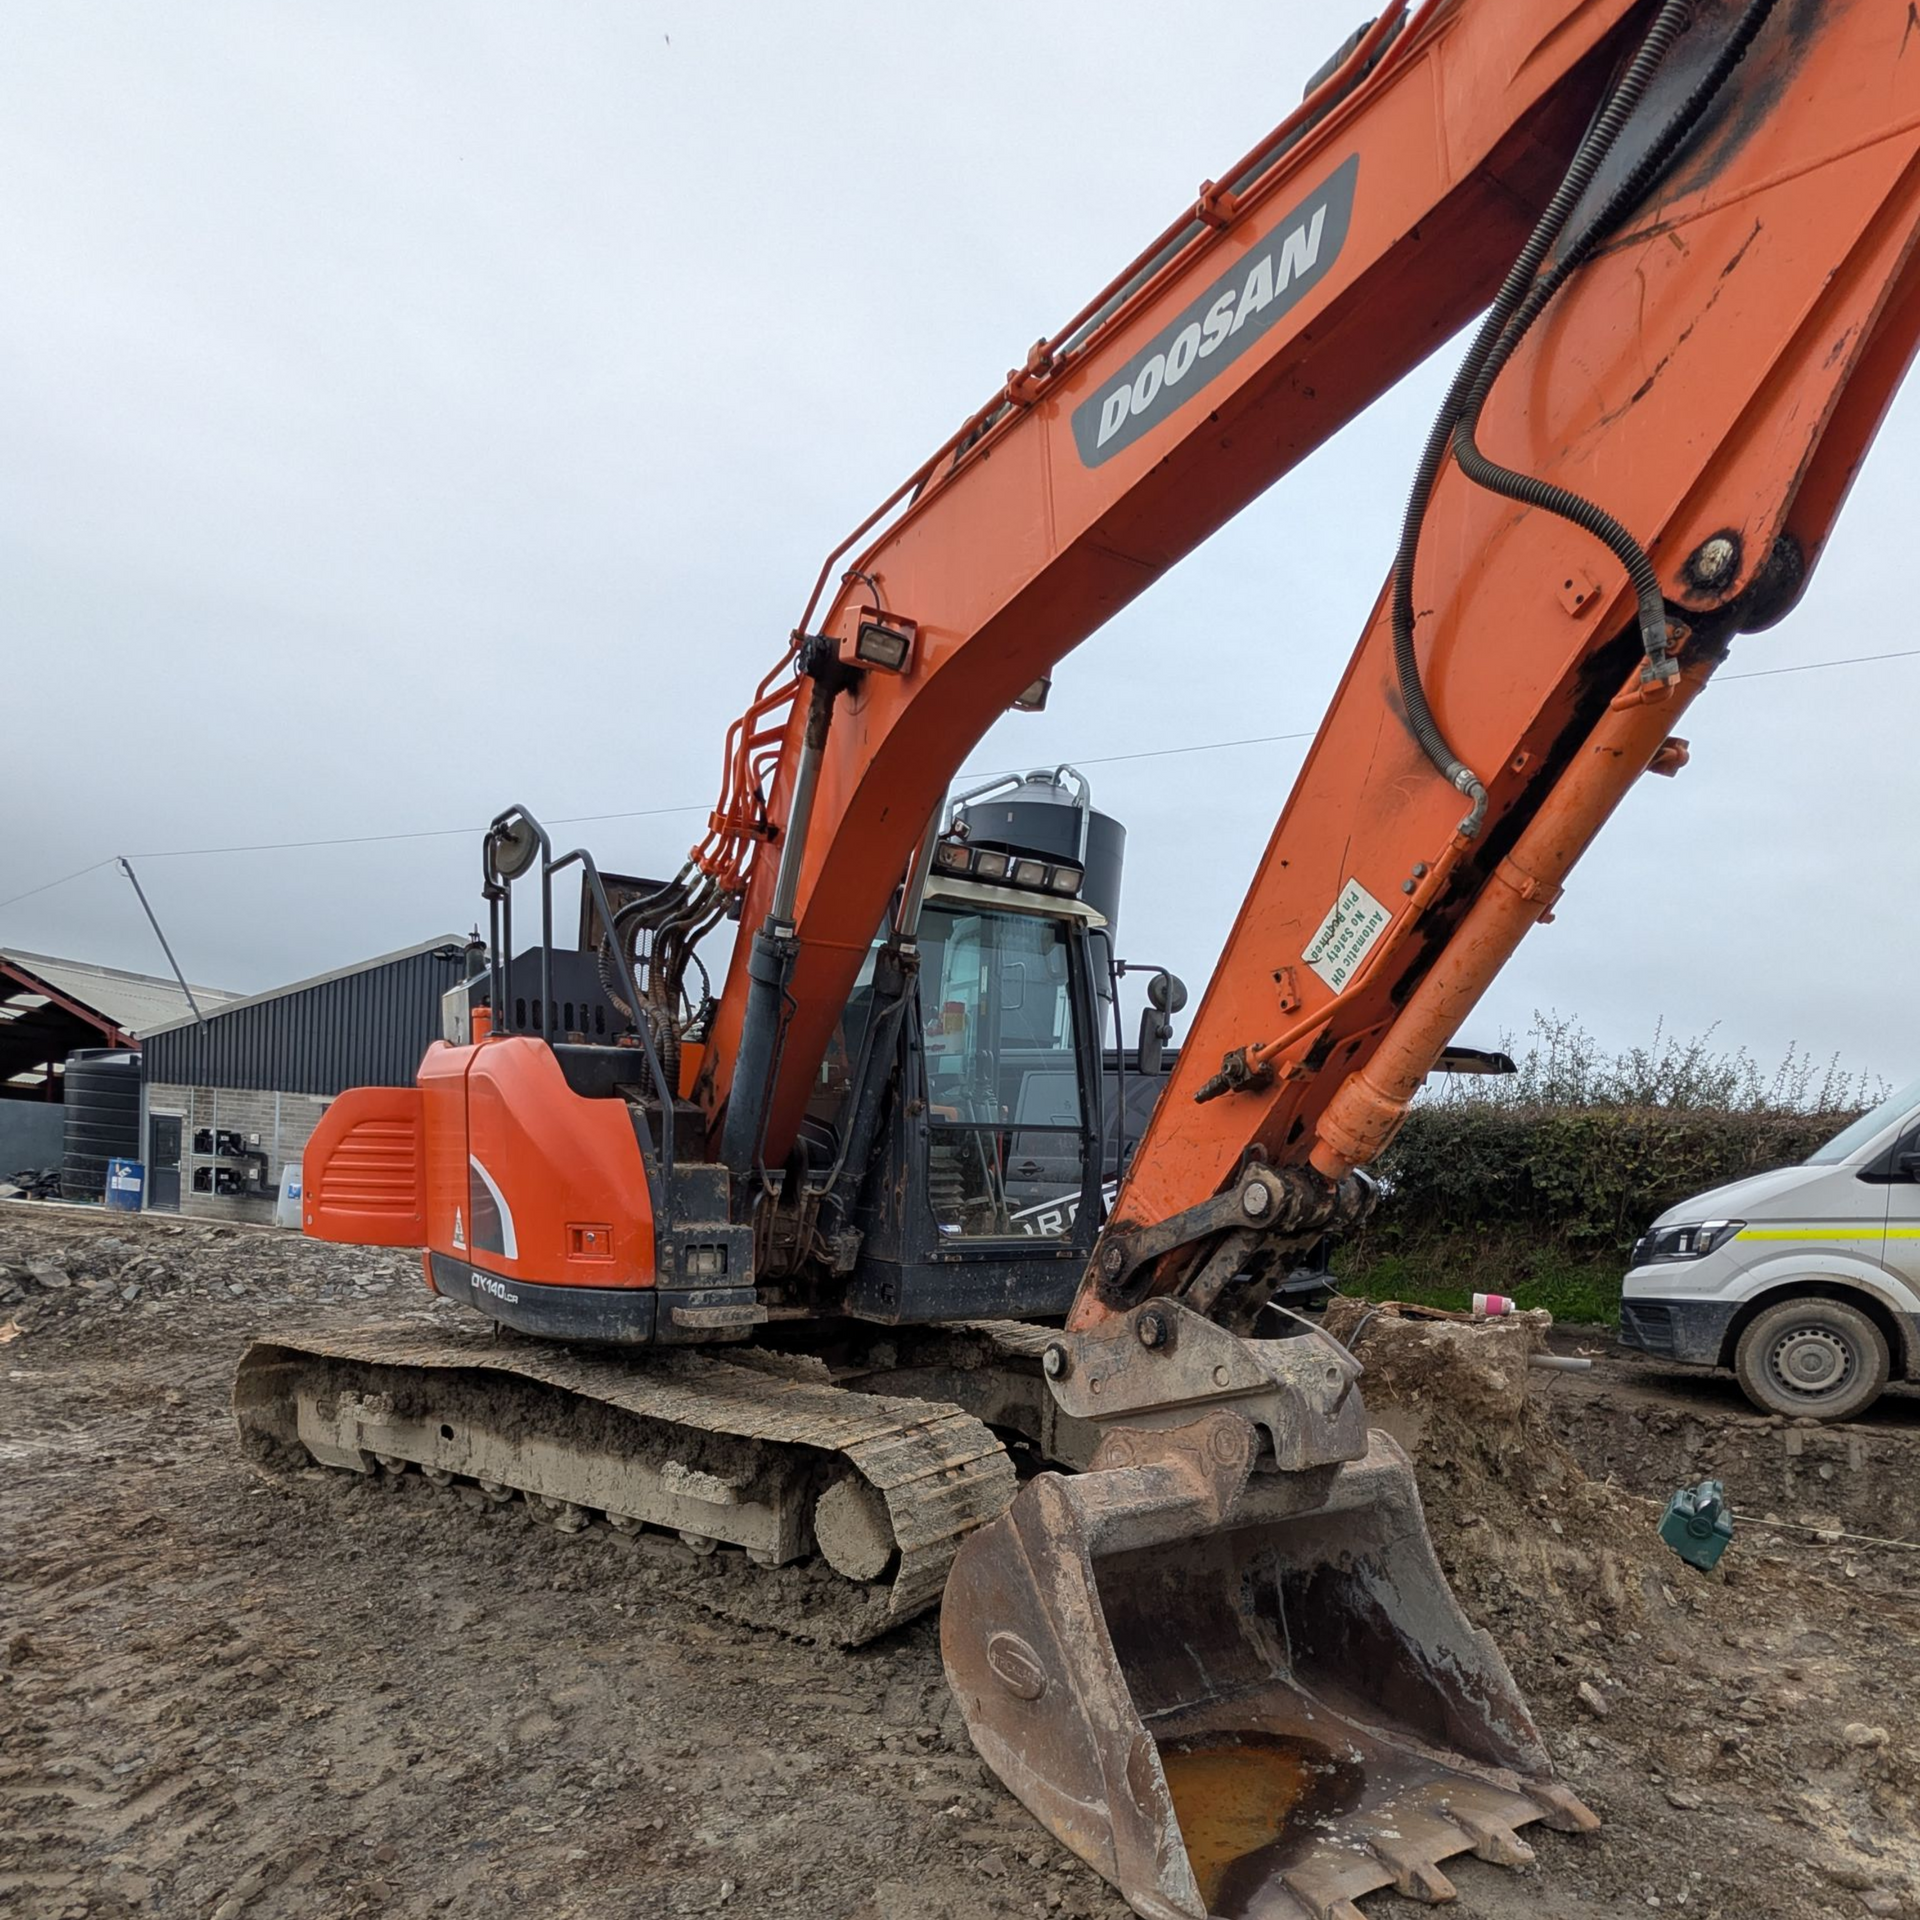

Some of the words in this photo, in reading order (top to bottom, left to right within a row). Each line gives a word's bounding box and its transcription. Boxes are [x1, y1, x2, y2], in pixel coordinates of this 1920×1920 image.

[1097, 203, 1327, 449] DOOSAN
[1342, 891, 1360, 911] Pin
[1351, 910, 1366, 927] No
[1326, 927, 1354, 963] Safety
[1343, 910, 1383, 967] Automatic
[1331, 967, 1346, 986] QH
